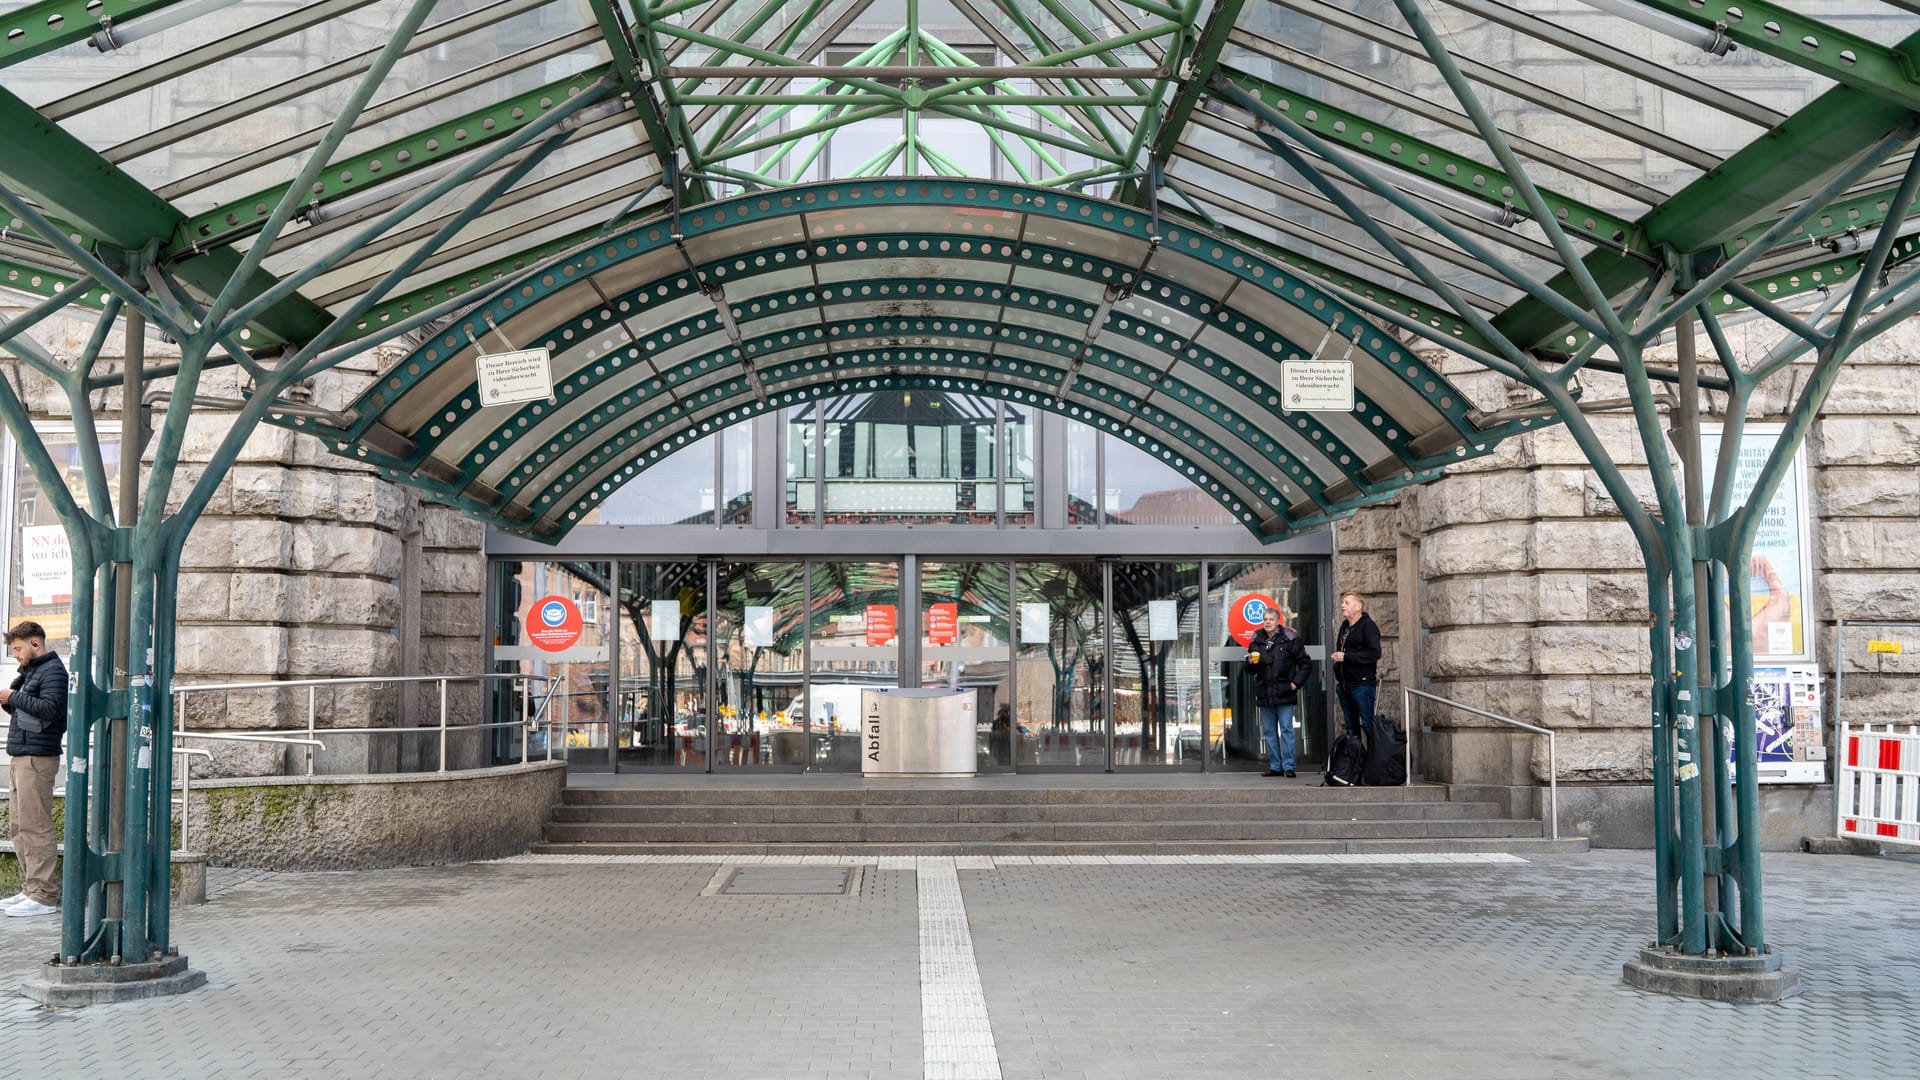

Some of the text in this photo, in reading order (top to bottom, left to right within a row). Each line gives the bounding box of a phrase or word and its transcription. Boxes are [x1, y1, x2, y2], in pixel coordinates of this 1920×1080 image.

[505, 358, 527, 366] Bereich
[511, 364, 540, 373] Sicherheit
[493, 372, 537, 383] videoüberwacht
[868, 715, 880, 762] Abfall
